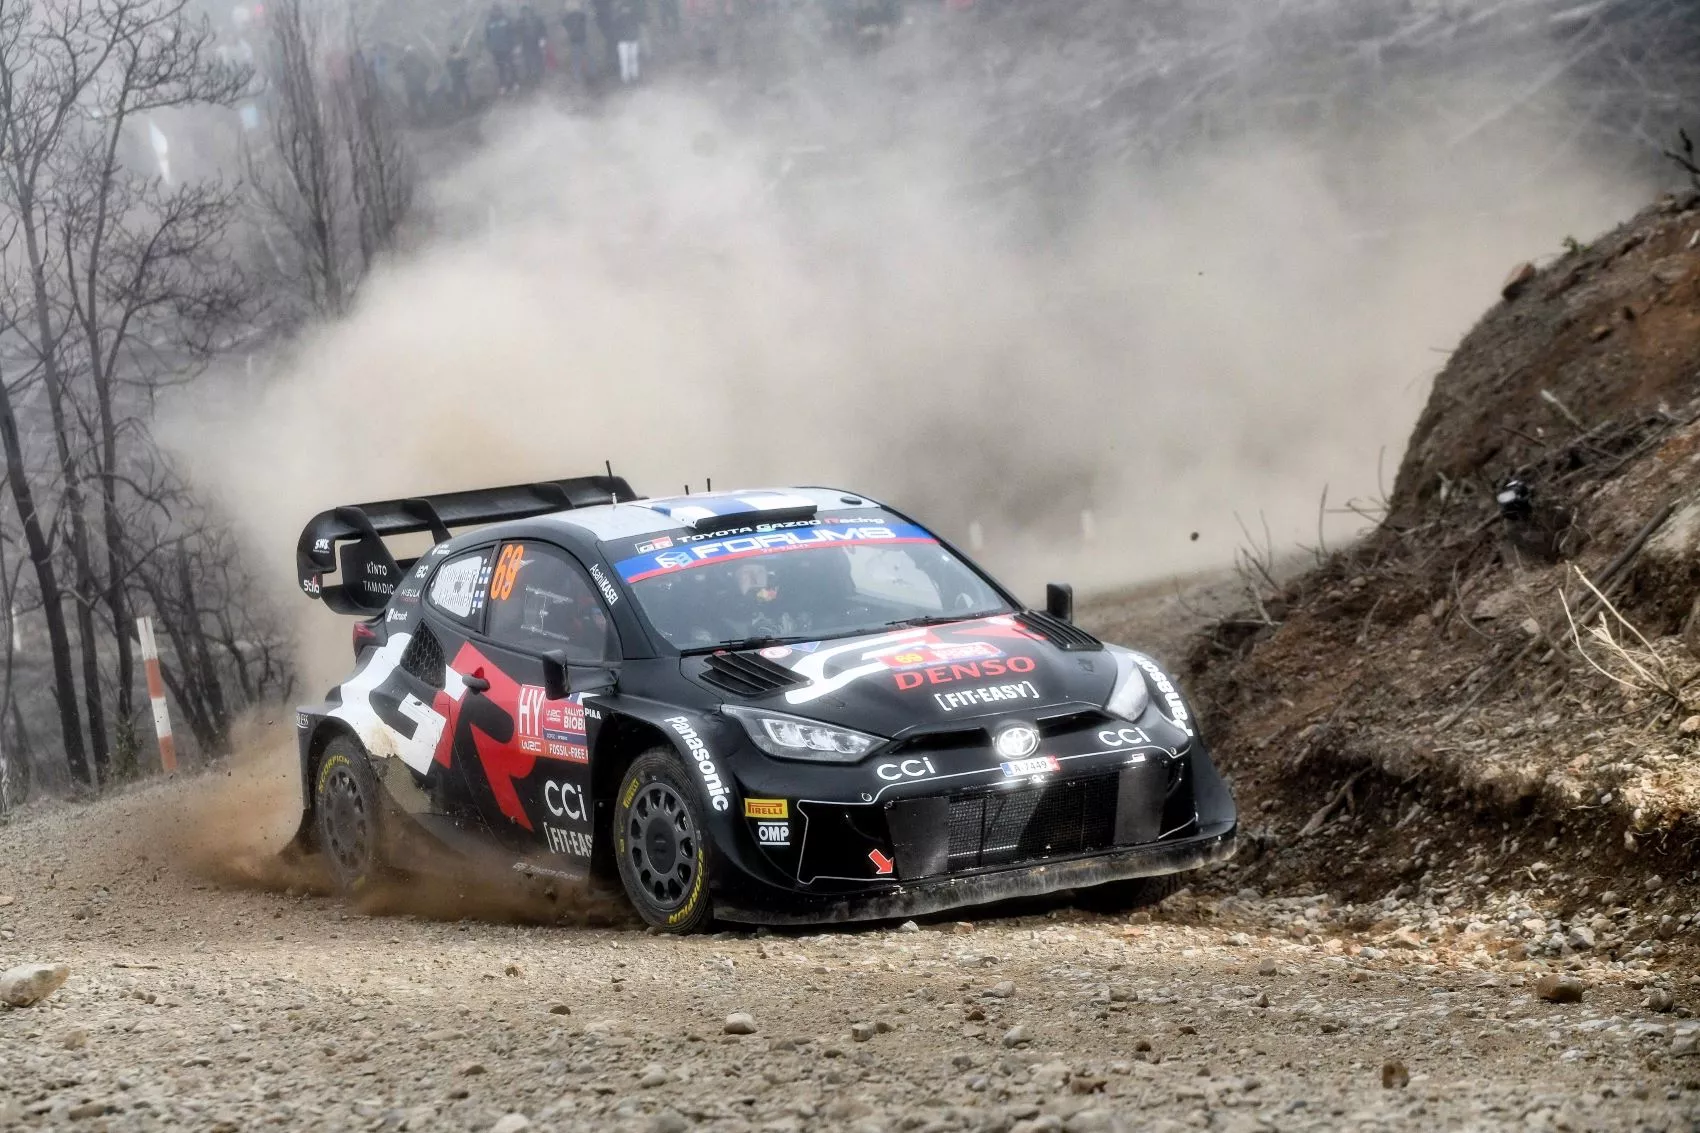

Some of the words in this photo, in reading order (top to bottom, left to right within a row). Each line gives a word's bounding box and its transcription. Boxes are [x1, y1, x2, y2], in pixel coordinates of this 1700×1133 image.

[677, 527, 752, 543] TOYOTA
[756, 518, 821, 533] GAZOO
[824, 516, 884, 525] Racing
[691, 527, 896, 559] FORUM8
[363, 581, 395, 595] TAMADIC
[491, 544, 524, 601] 69
[590, 564, 619, 606] AsahiKASEI
[893, 656, 1036, 691] DENSO
[519, 687, 546, 737] HY
[584, 707, 602, 720] PIAA
[664, 716, 730, 812] Panasonic
[747, 802, 783, 815] PIRELLI
[758, 825, 790, 842] OMP
[668, 848, 704, 925] SCORPION
